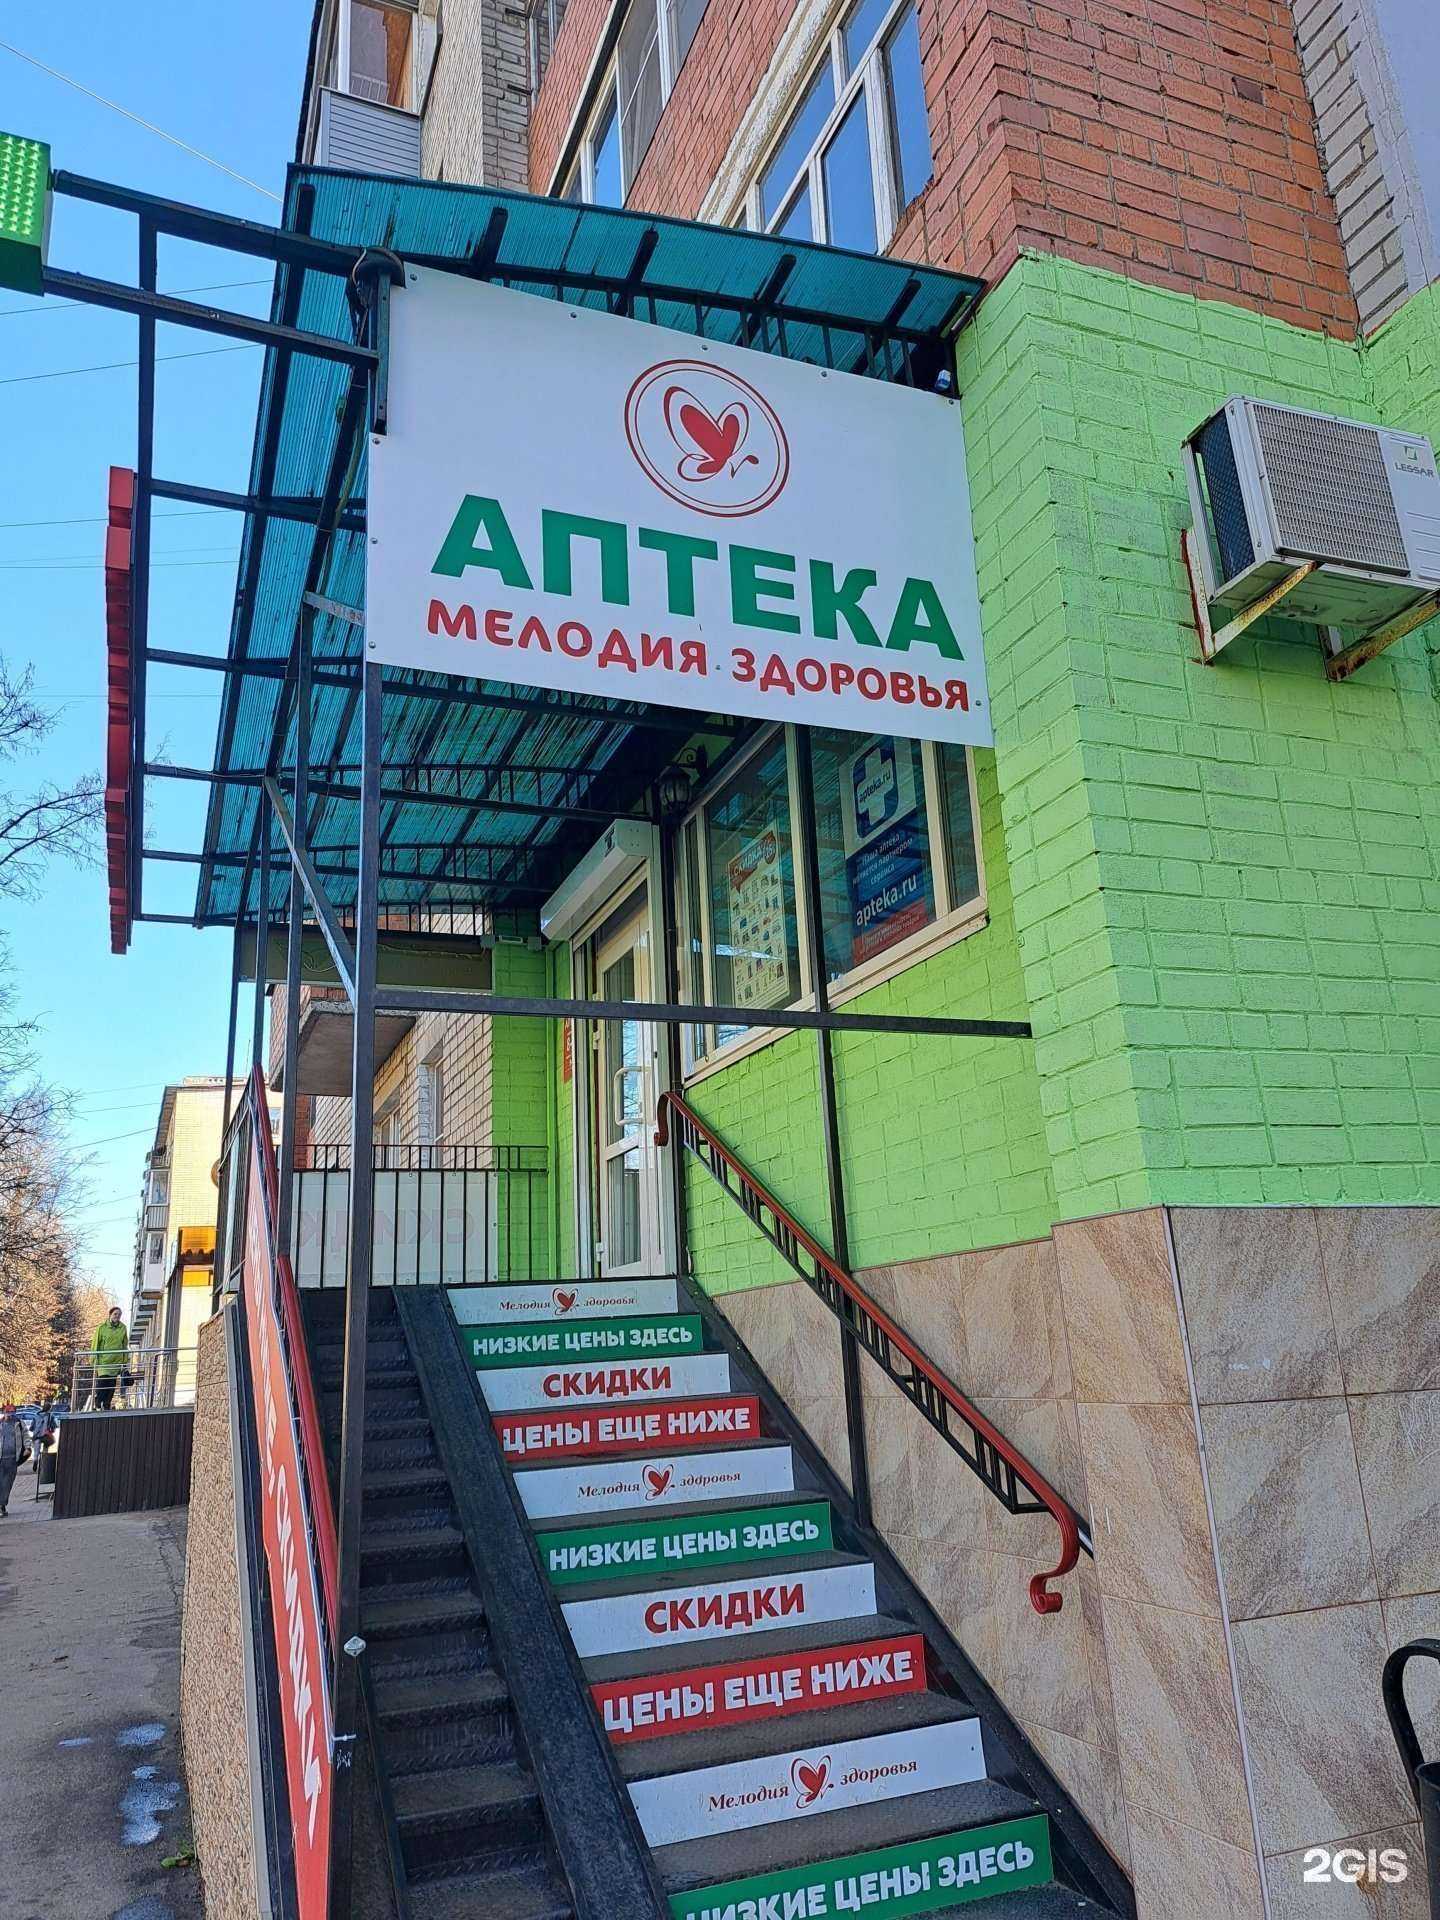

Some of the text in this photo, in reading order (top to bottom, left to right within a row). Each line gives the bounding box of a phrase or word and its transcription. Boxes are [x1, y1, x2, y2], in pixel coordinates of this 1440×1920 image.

[1394, 461, 1434, 477] LESSAR
[432, 494, 965, 662] АПТЕКА
[427, 599, 969, 711] МЕЛОДИЯ ЗДОРОВЬЯ
[859, 769, 891, 804] apteka.ru
[856, 874, 917, 927] apteka.ru
[499, 1296, 635, 1312] Мелодия здоровья
[473, 1327, 693, 1355] НИЗКИЕ ЦЕНЫ ЗДЕСЬ
[542, 1366, 672, 1398] СКИДКИ
[502, 1407, 751, 1454] ЦЕНЫ ЕЩЕ НИЖЕ
[577, 1471, 741, 1498] Мелодия здоровья
[549, 1519, 819, 1571] НИЗКИЕ ЦЕНЫ ЗДЕСЬ
[644, 1583, 805, 1634] СКИДКИ
[276, 1464, 322, 1848] СКИДКИ
[603, 1650, 914, 1733] ЦЕНЫ ЕЩЕ НИЖЕ
[707, 1760, 918, 1812] Мелодия здоровья
[834, 1862, 931, 1912] ЦЕНЫ
[937, 1840, 1034, 1888] ЗДЕСЬ
